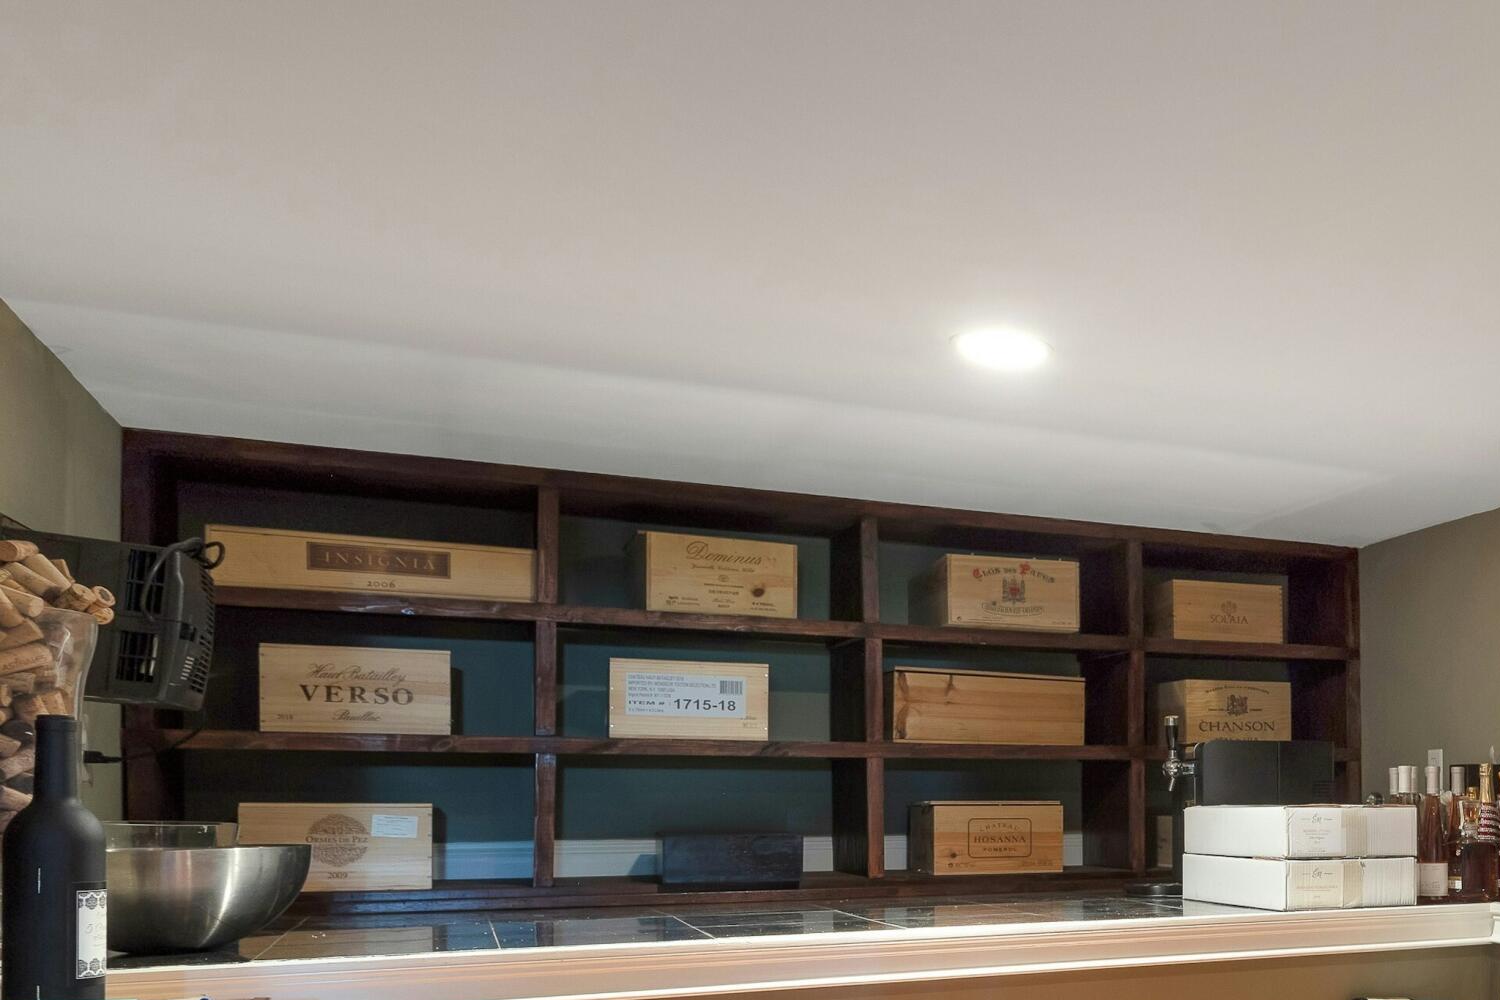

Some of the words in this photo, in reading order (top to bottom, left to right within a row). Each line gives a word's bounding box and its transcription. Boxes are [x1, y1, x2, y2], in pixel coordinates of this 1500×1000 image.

[686, 541, 762, 566] Dominus
[323, 550, 437, 571] INSIGNIA
[366, 580, 397, 589] 2006
[1210, 614, 1249, 625] SOLAIA
[299, 684, 414, 706] VERSO
[674, 698, 737, 711] 1715-18
[1198, 720, 1275, 733] CHANSON
[974, 835, 1027, 844] HOSANNA
[327, 871, 348, 880] 2009
